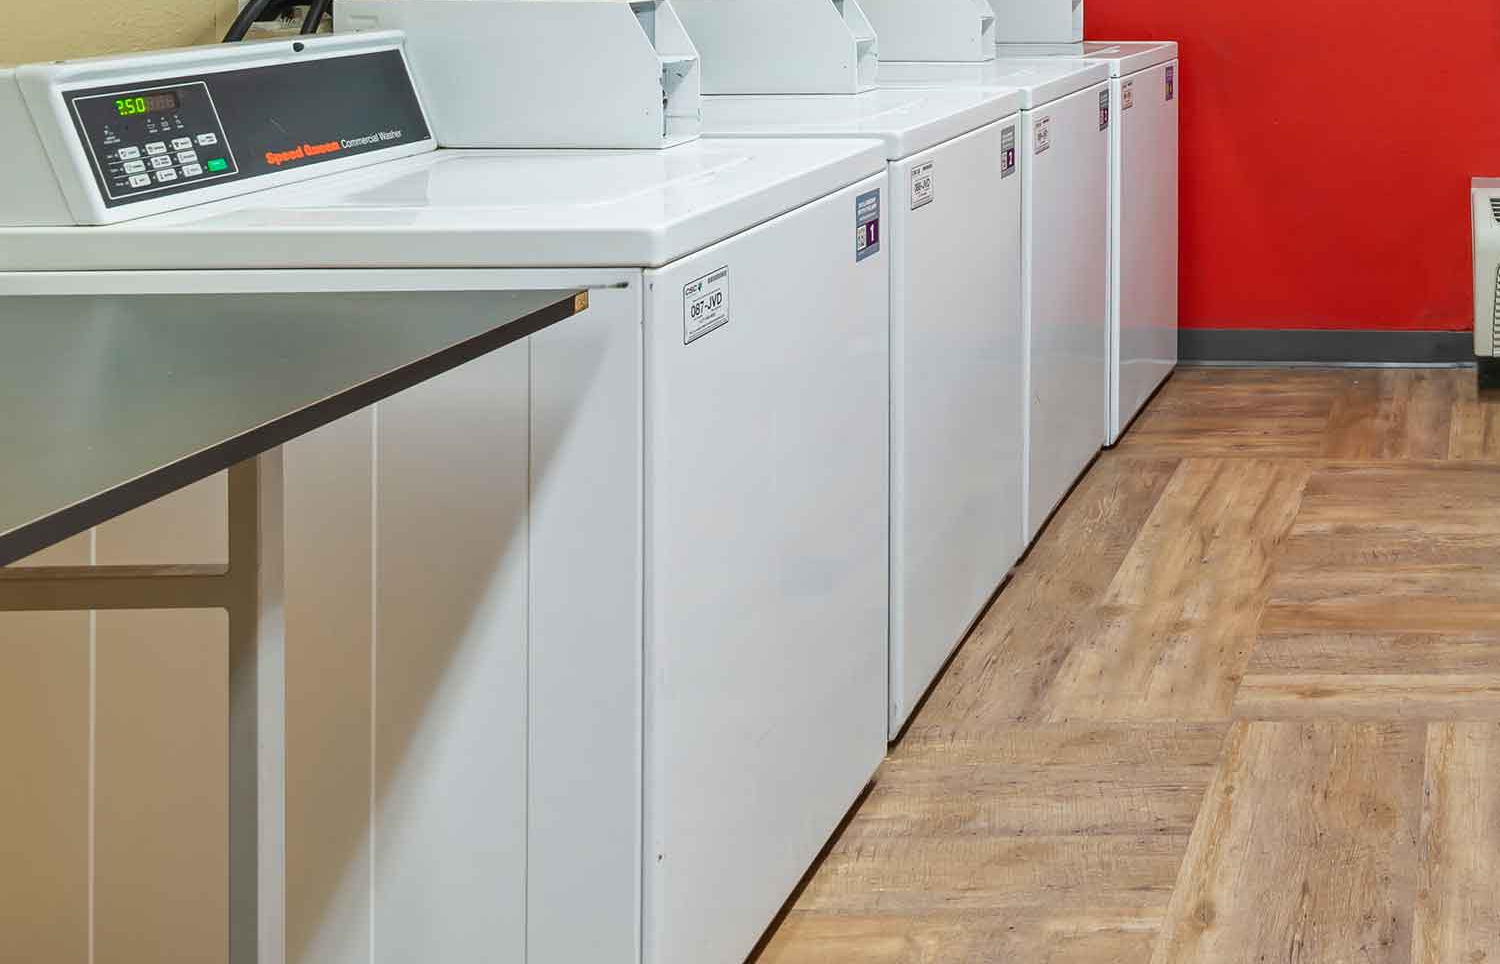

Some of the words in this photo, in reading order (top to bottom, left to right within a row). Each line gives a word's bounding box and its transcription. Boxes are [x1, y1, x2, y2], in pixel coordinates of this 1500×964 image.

[340, 132, 379, 149] Commercial
[378, 129, 402, 142] Washer
[265, 145, 304, 166] Speed
[303, 140, 341, 157] Queen
[869, 222, 875, 242] 1
